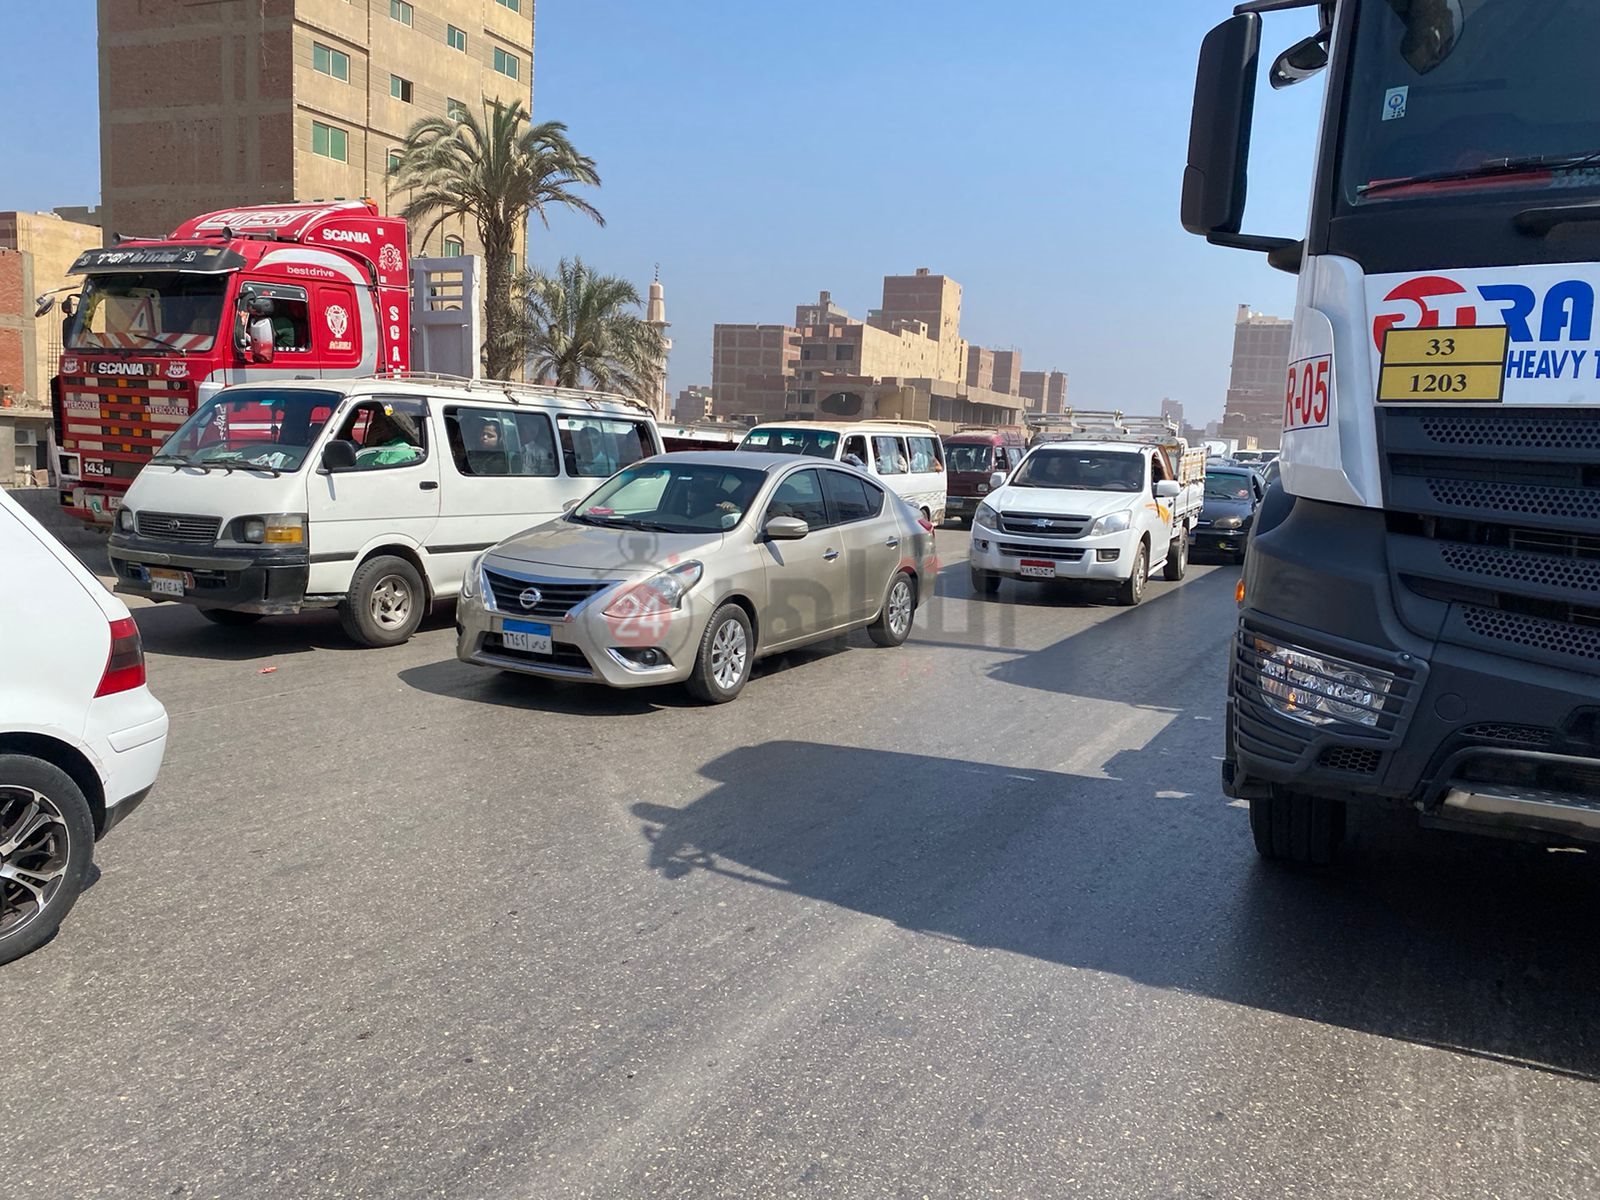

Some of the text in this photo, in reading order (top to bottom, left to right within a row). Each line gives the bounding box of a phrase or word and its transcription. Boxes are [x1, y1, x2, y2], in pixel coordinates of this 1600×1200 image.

[323, 229, 371, 245] SCANIA
[287, 265, 335, 277] bestdrive
[1425, 338, 1455, 356] 33
[98, 361, 145, 376] SCANIA
[1506, 350, 1587, 379] HEAVY
[1409, 373, 1468, 393] 1203
[1286, 360, 1329, 426] R-05
[144, 405, 189, 416] INTERCOOLER
